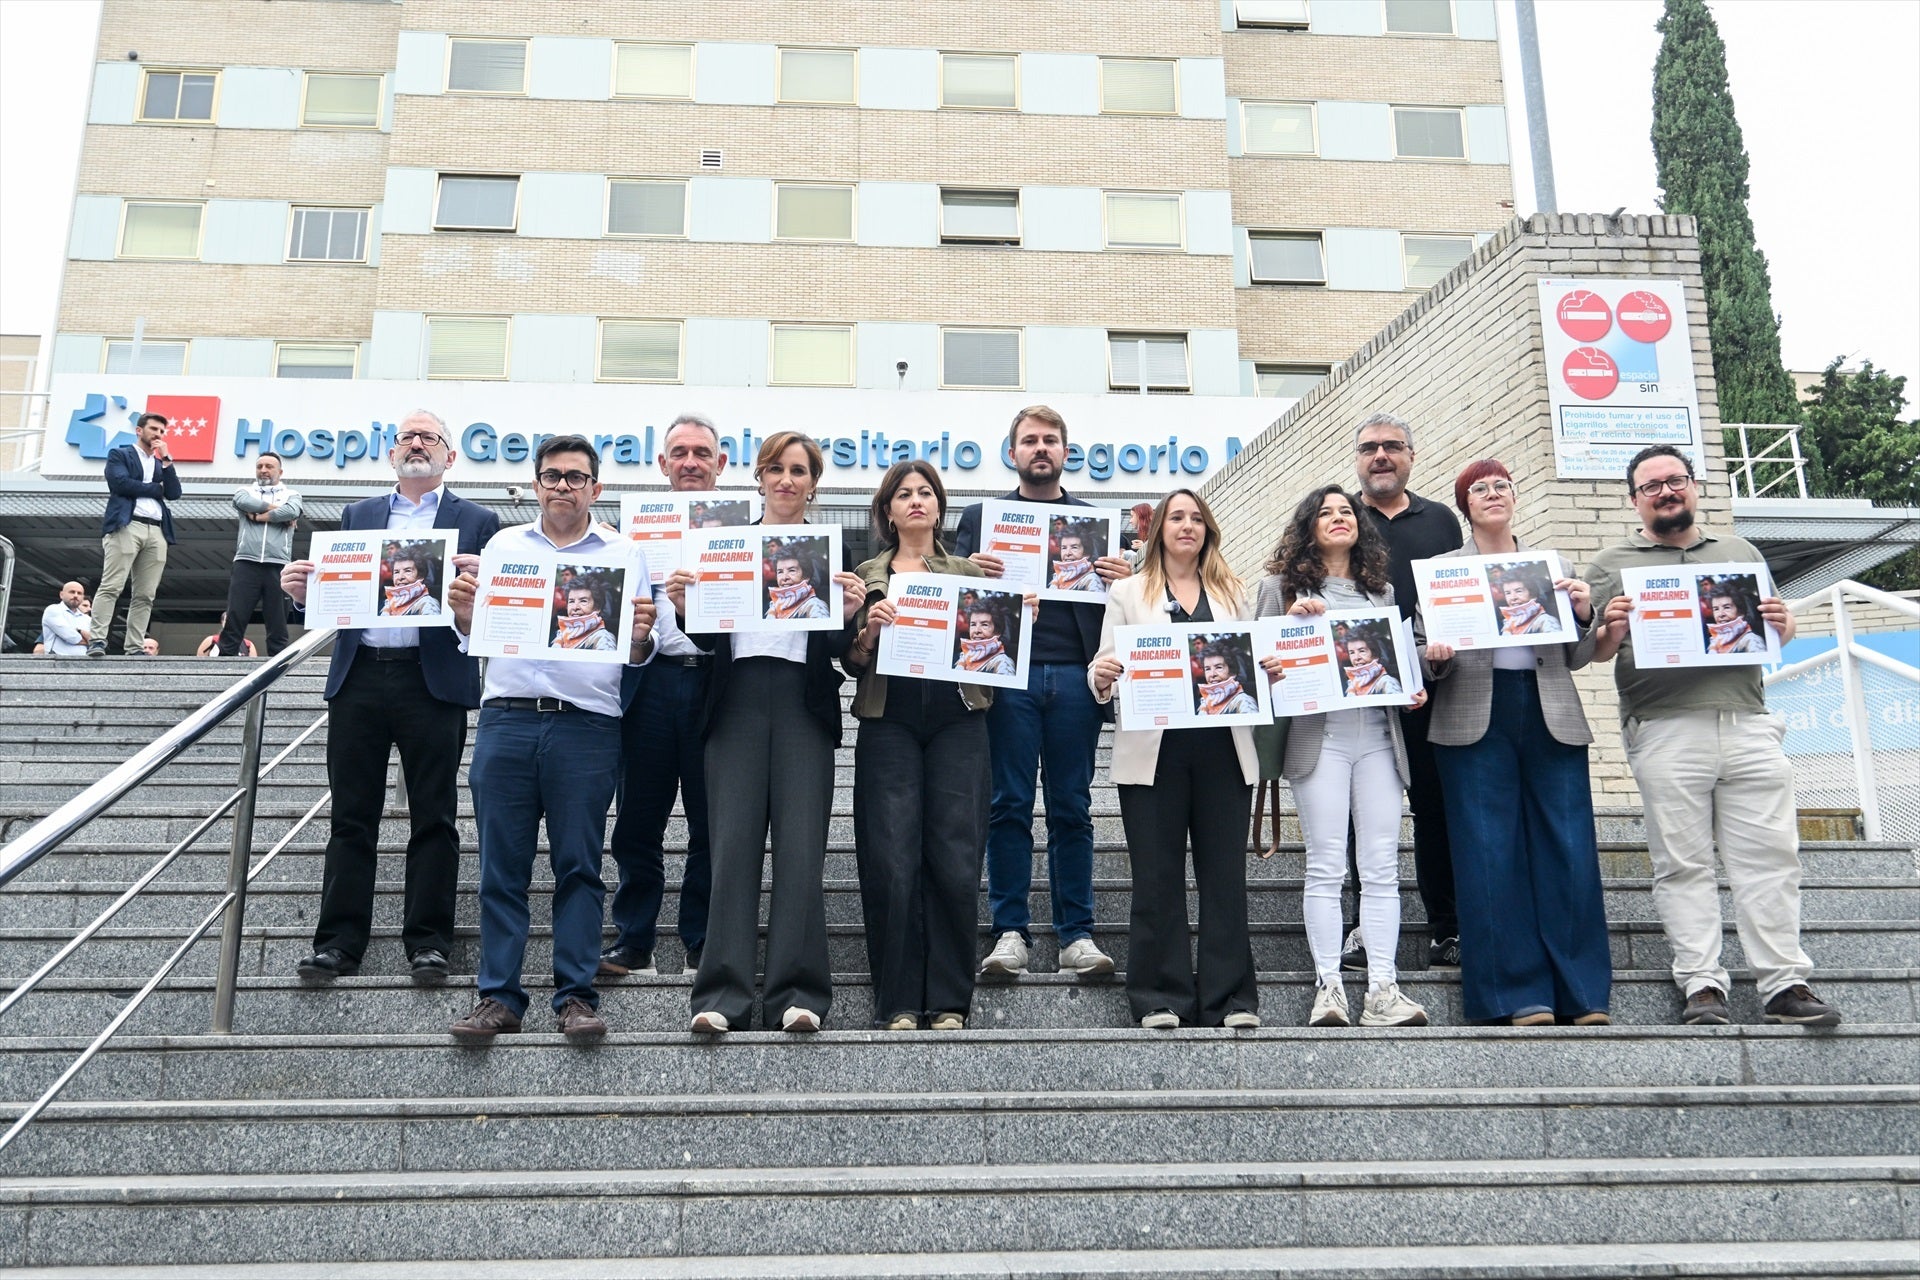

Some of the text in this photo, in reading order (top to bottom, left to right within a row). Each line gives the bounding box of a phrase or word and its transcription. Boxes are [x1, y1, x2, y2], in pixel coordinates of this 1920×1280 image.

[1620, 371, 1658, 381] espacio
[1640, 381, 1659, 393] sin
[1564, 411, 1606, 420] Prohibido
[1609, 411, 1634, 420] fumar
[1637, 414, 1642, 422] y
[1645, 412, 1653, 420] el
[1675, 412, 1686, 420] de
[1565, 421, 1608, 430] cigarrillos
[234, 418, 398, 468] Hospit
[461, 422, 655, 464] Genral
[719, 427, 982, 470] nirsitario
[1001, 435, 1209, 481] egorio
[640, 503, 674, 513] DECRETO
[632, 514, 682, 524] MARICARMEN
[1001, 512, 1035, 524] DECRETO
[993, 524, 1042, 537] MARICARMEN
[331, 543, 366, 551] DECRETO
[708, 539, 745, 550] DECRETO
[322, 554, 372, 563] MARICARMEN
[699, 551, 754, 563] MARICARMEN
[501, 563, 539, 576] DECRETO
[1435, 567, 1469, 579] DECRETO
[491, 577, 547, 589] MARICARMEN
[1430, 578, 1480, 590] MARICARMEN
[1646, 578, 1680, 589] DECRETO
[906, 584, 942, 597] DECRETO
[1640, 590, 1689, 601] MARICARMEN
[896, 596, 950, 611] MARICARMEN
[1280, 625, 1315, 638] DECRETO
[1137, 636, 1172, 648] DECRETO
[1276, 636, 1325, 651] MARICARMEN
[1129, 649, 1181, 661] MARICARMEN
